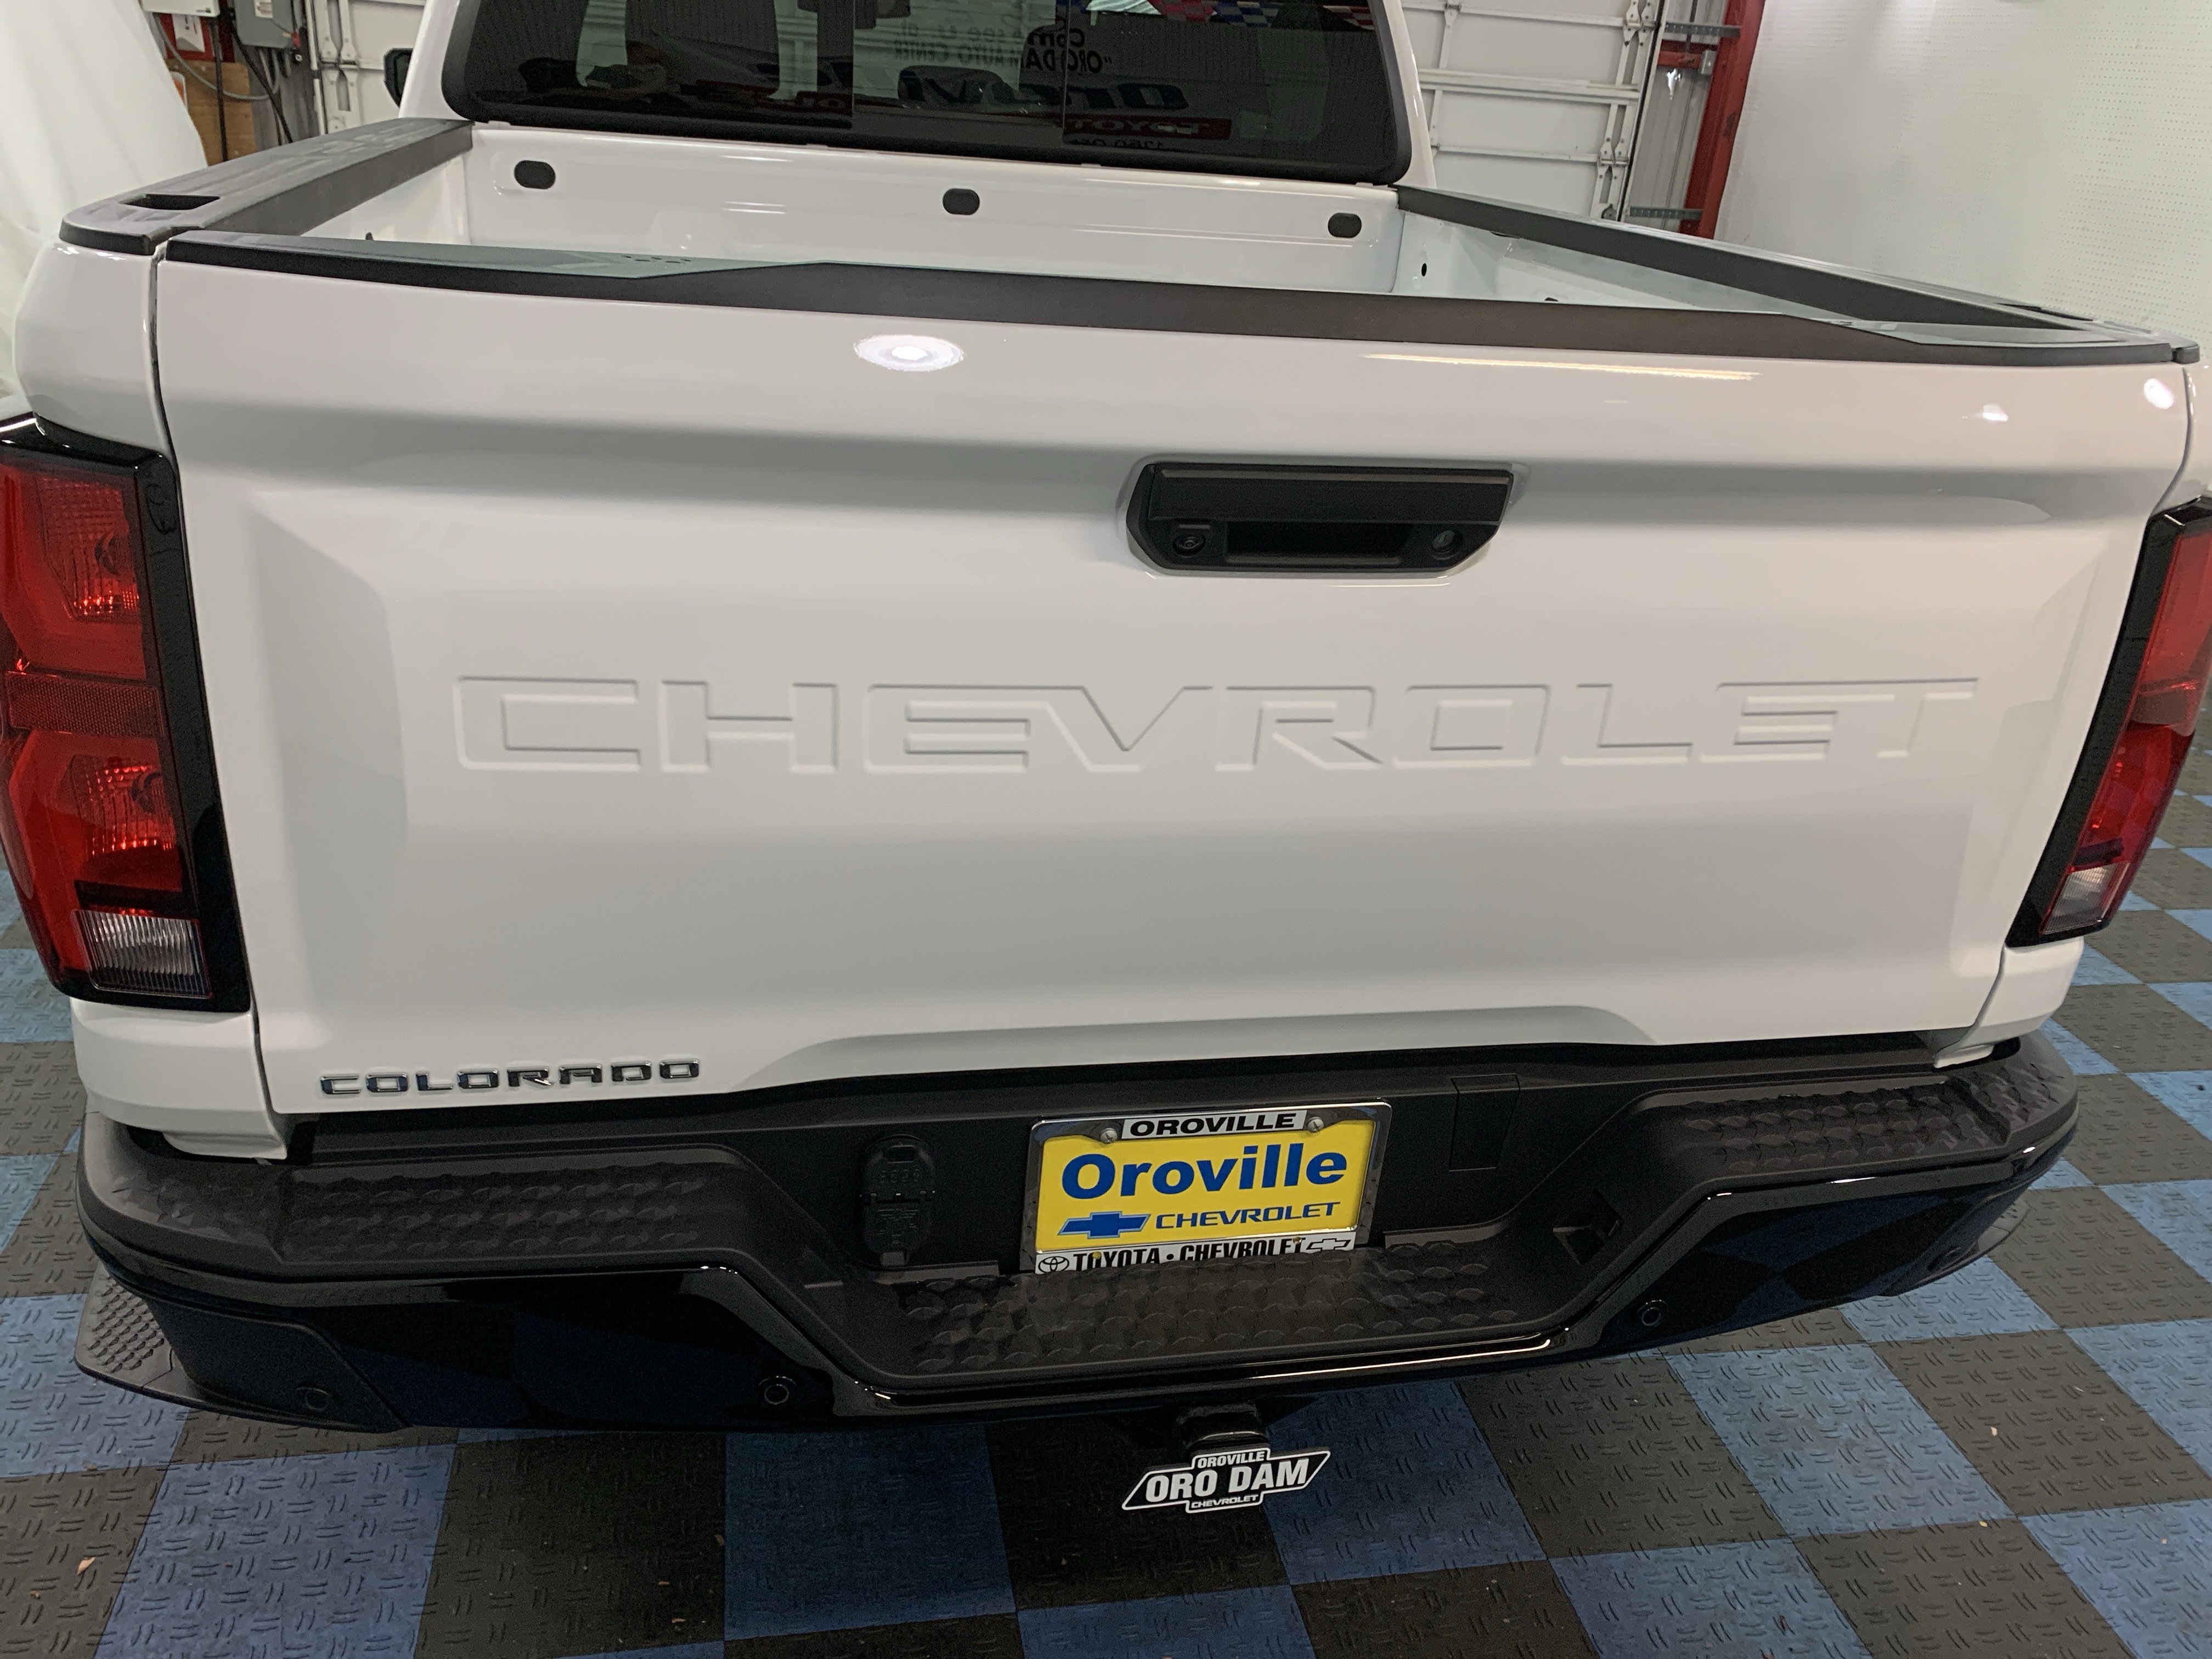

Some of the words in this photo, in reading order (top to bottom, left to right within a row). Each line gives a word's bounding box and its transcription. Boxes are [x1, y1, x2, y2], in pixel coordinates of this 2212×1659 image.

[453, 675, 1979, 772] CHEVROLET
[320, 1058, 700, 1095] COLORADO
[1129, 1113, 1295, 1137] OROVILLE
[1062, 1143, 1347, 1200] Oroville
[1155, 1202, 1341, 1229] CHEVROLET
[1074, 1247, 1160, 1272] TOYOTA
[1180, 1238, 1306, 1262] CHEVROLET
[1197, 1451, 1265, 1469] OROVILLE
[1146, 1469, 1218, 1503] ORO
[1228, 1458, 1310, 1493] DAM
[1191, 1494, 1259, 1509] CHEVROLET
